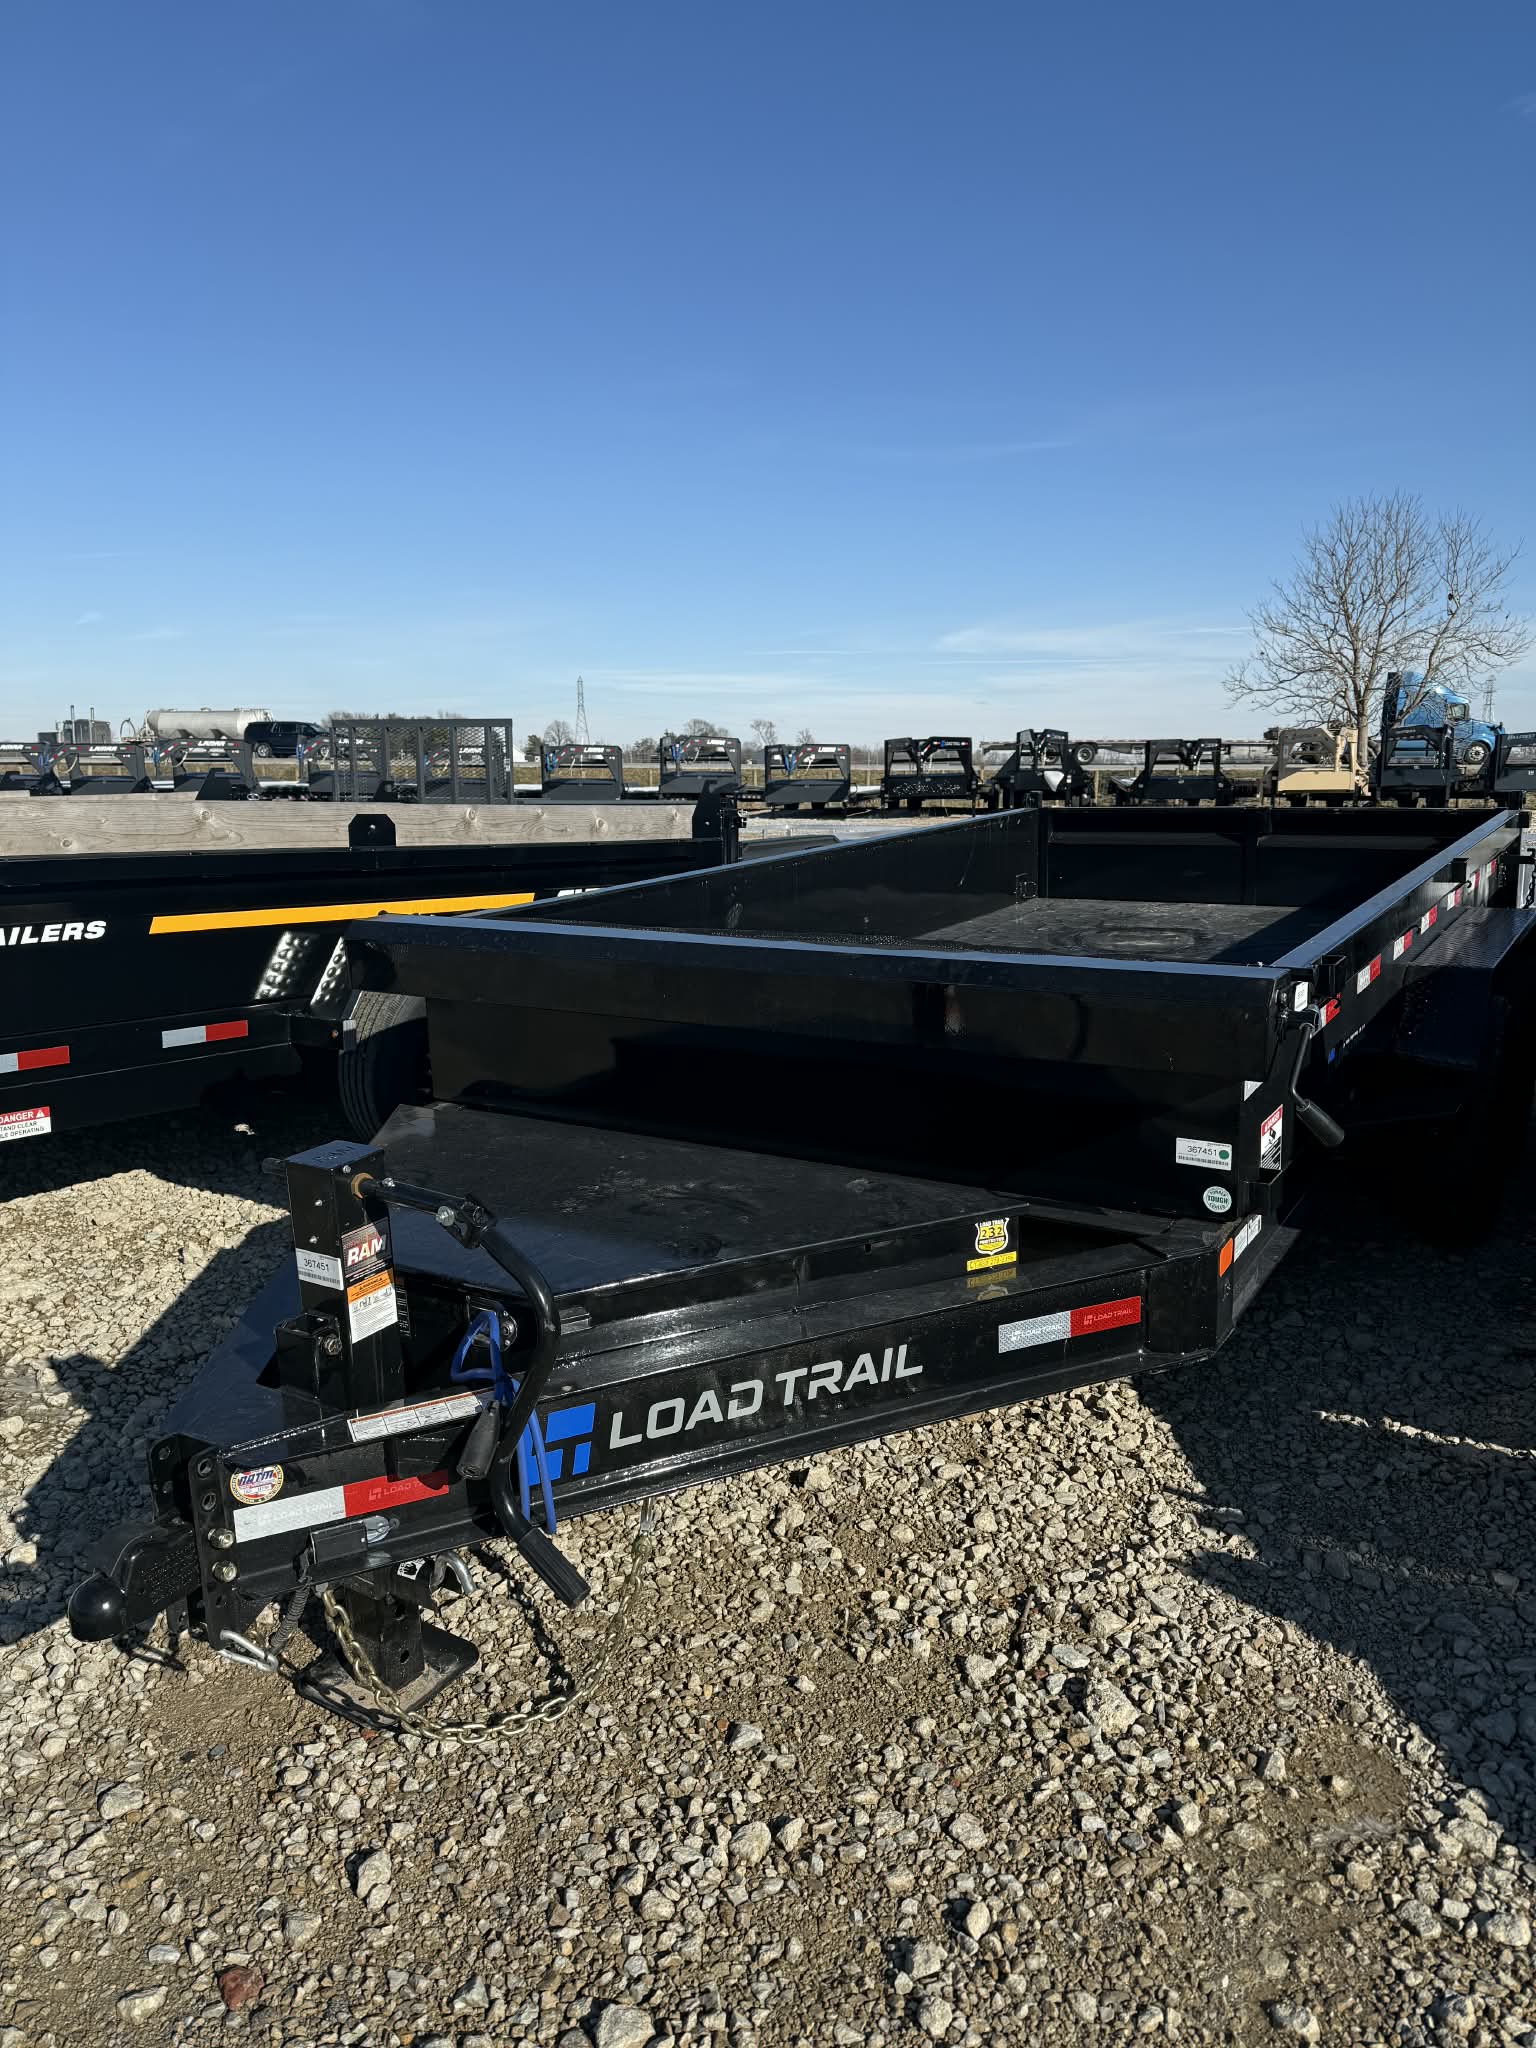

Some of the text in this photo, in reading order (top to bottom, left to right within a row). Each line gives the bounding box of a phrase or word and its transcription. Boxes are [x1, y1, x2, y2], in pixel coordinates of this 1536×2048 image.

[1187, 1145, 1217, 1156] 367451
[981, 1226, 1003, 1238] 232
[347, 1234, 387, 1267] RAM
[303, 1258, 329, 1272] 367451
[1093, 1312, 1113, 1321] LOAD
[608, 1343, 924, 1450] LOAD TRAIL
